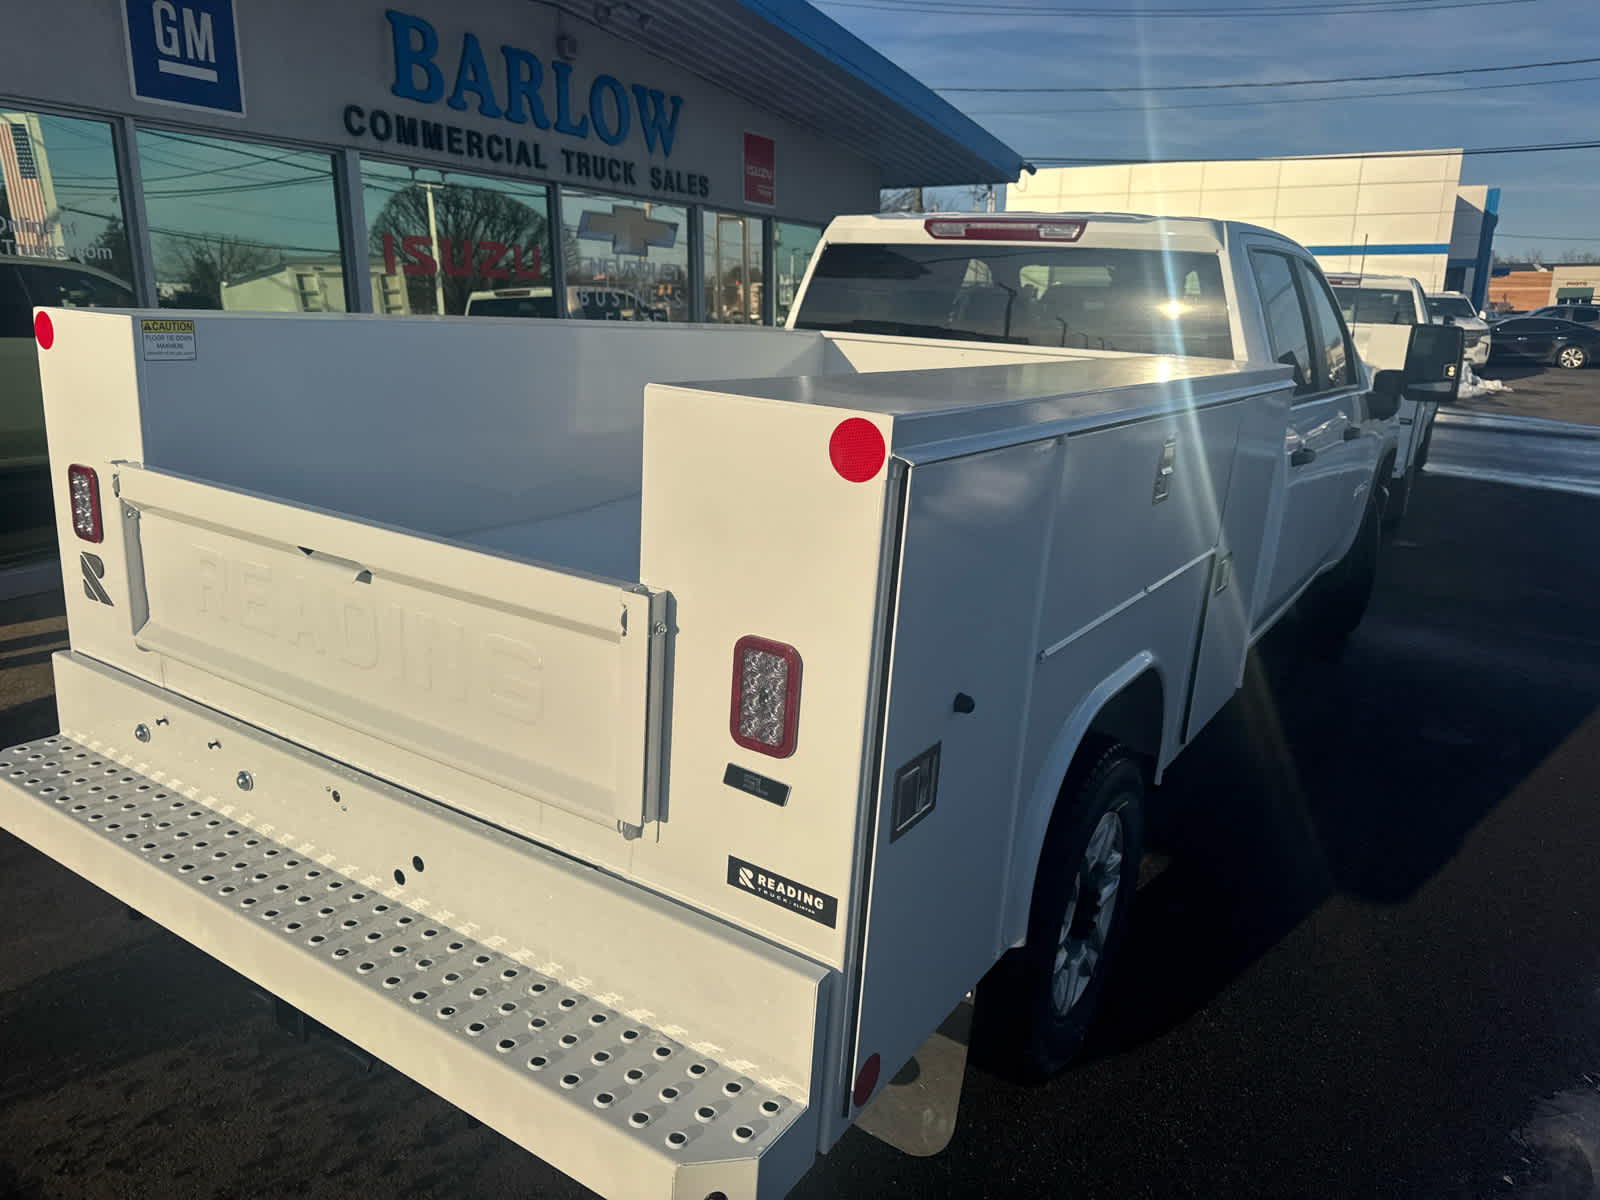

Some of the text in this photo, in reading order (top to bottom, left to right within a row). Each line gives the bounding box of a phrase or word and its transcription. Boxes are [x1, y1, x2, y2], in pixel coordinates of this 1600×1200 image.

[152, 0, 216, 63] GM
[385, 8, 684, 158] BARLOW
[343, 104, 711, 198] COMMERCIAL TRUCK SALES
[381, 232, 542, 281] ISUZU
[579, 287, 683, 310] BUSINESS
[152, 321, 192, 331] CAUTION
[757, 873, 825, 910] READING
